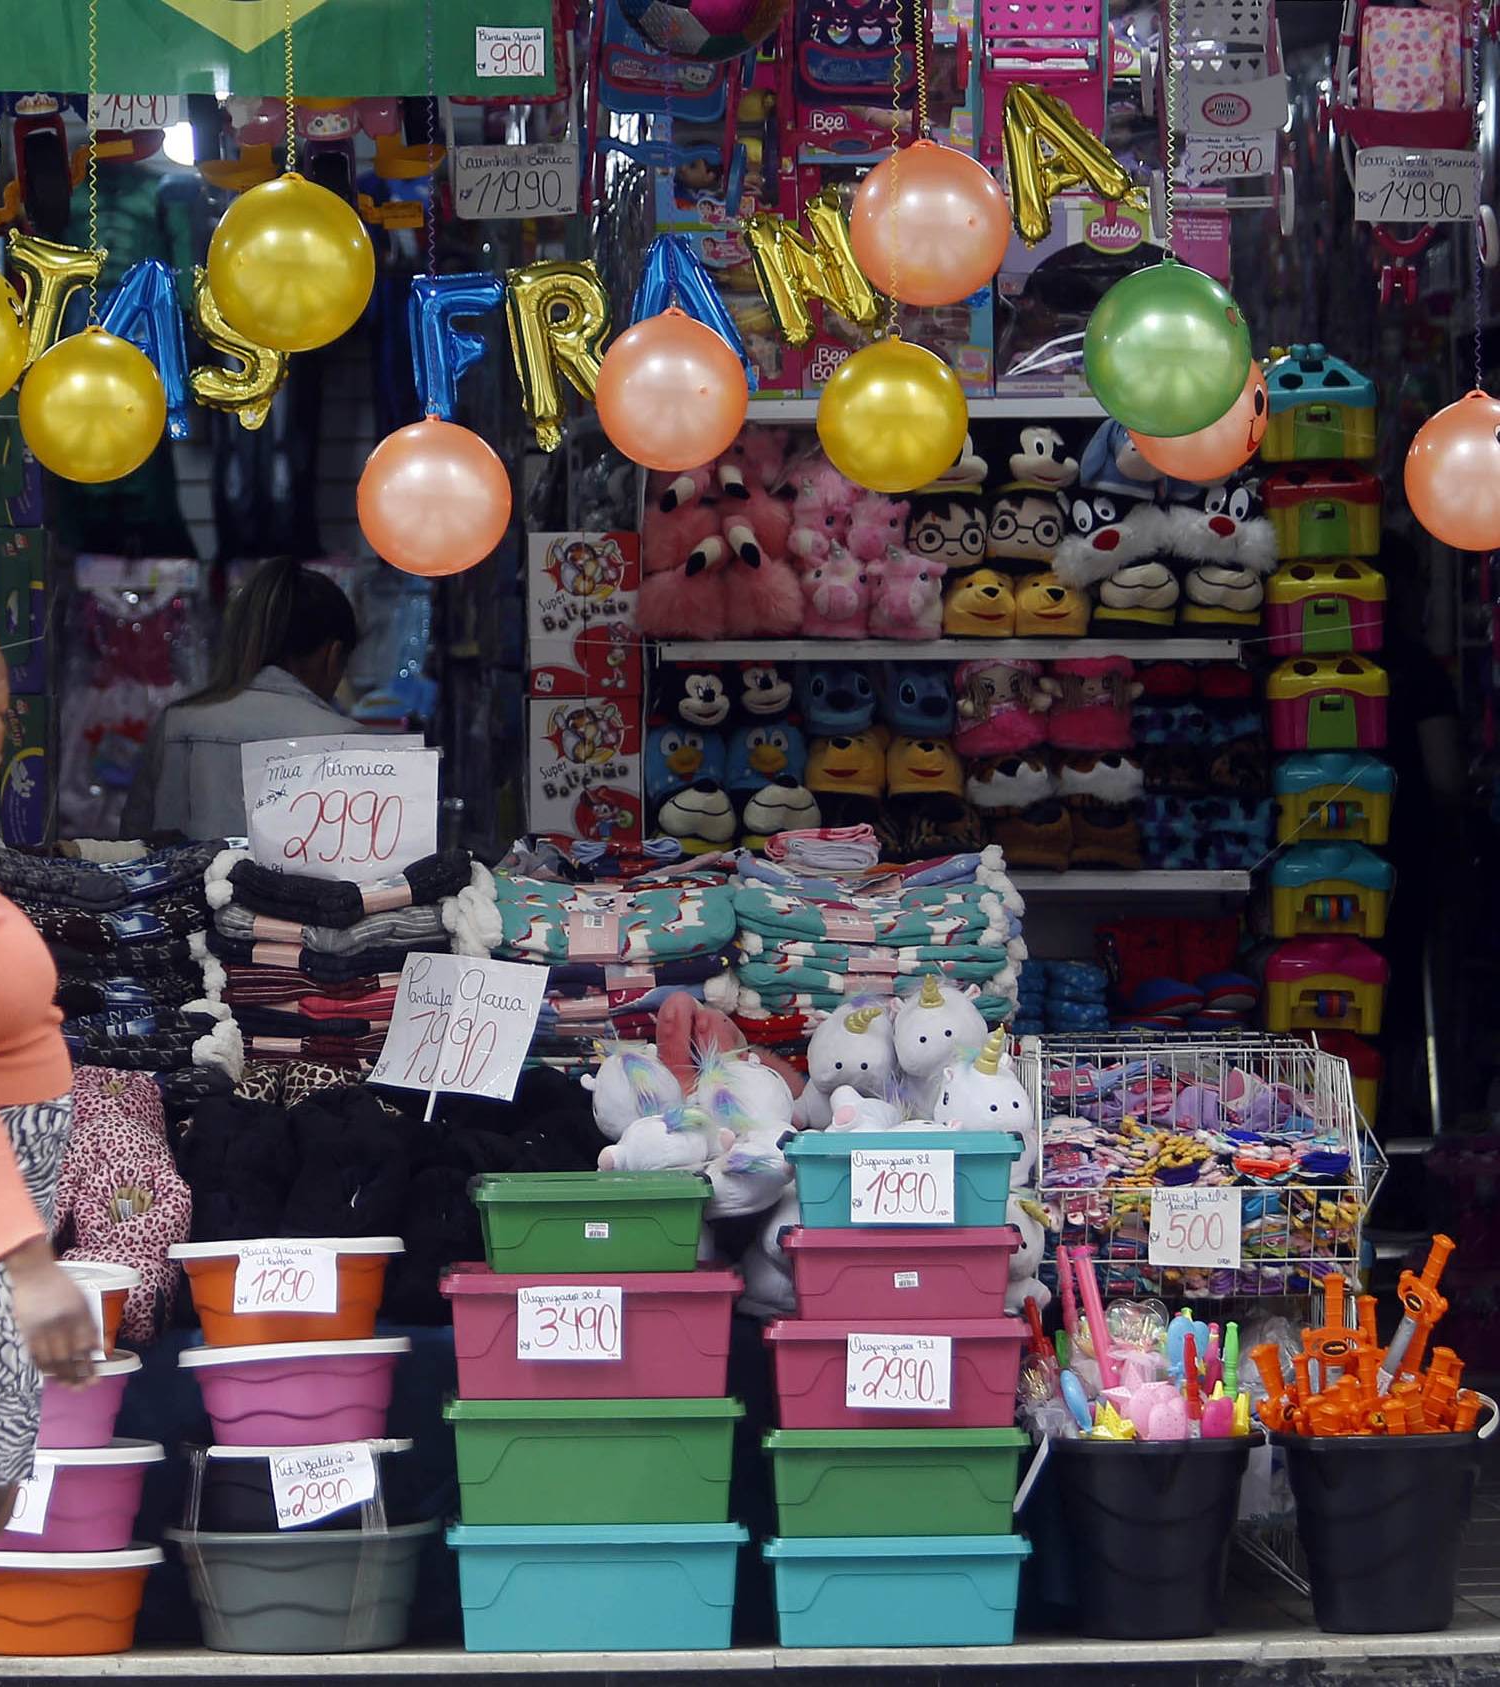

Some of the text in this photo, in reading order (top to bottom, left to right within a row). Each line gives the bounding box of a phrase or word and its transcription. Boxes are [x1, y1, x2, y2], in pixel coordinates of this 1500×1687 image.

[811, 112, 845, 131] Bee
[817, 348, 850, 364] Bee
[538, 595, 566, 612] Super
[539, 761, 567, 781] Super
[406, 956, 453, 1011] Pantufa
